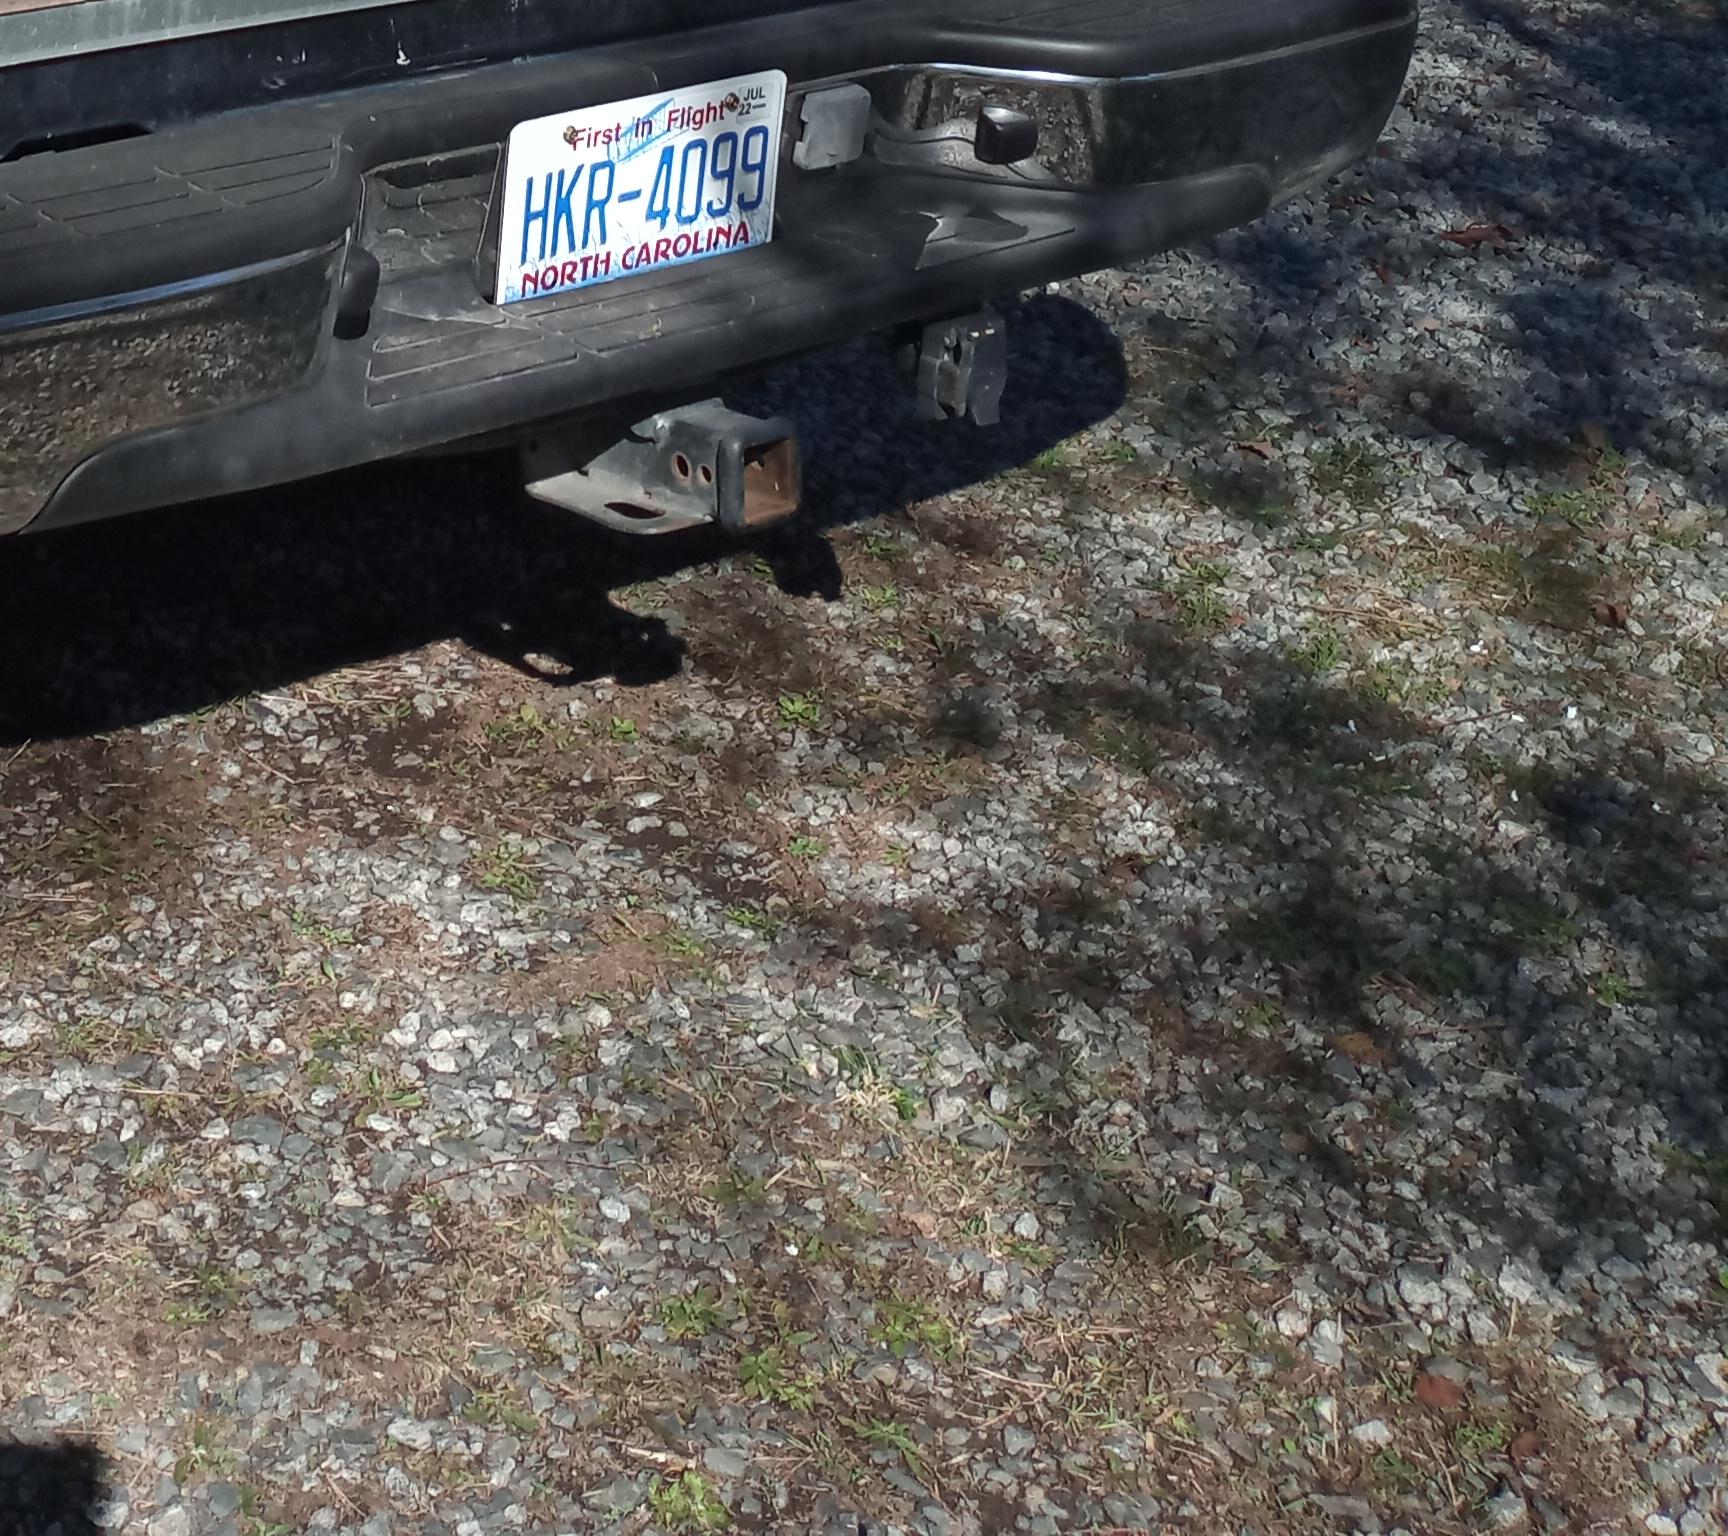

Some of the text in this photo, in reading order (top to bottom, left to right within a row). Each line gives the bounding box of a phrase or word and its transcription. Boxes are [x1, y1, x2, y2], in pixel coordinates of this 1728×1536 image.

[572, 122, 622, 151] First
[667, 100, 726, 133] Flight
[743, 86, 766, 102] JUL
[520, 124, 769, 263] HKR-4099
[521, 220, 750, 298] NORTH CAROLINA
